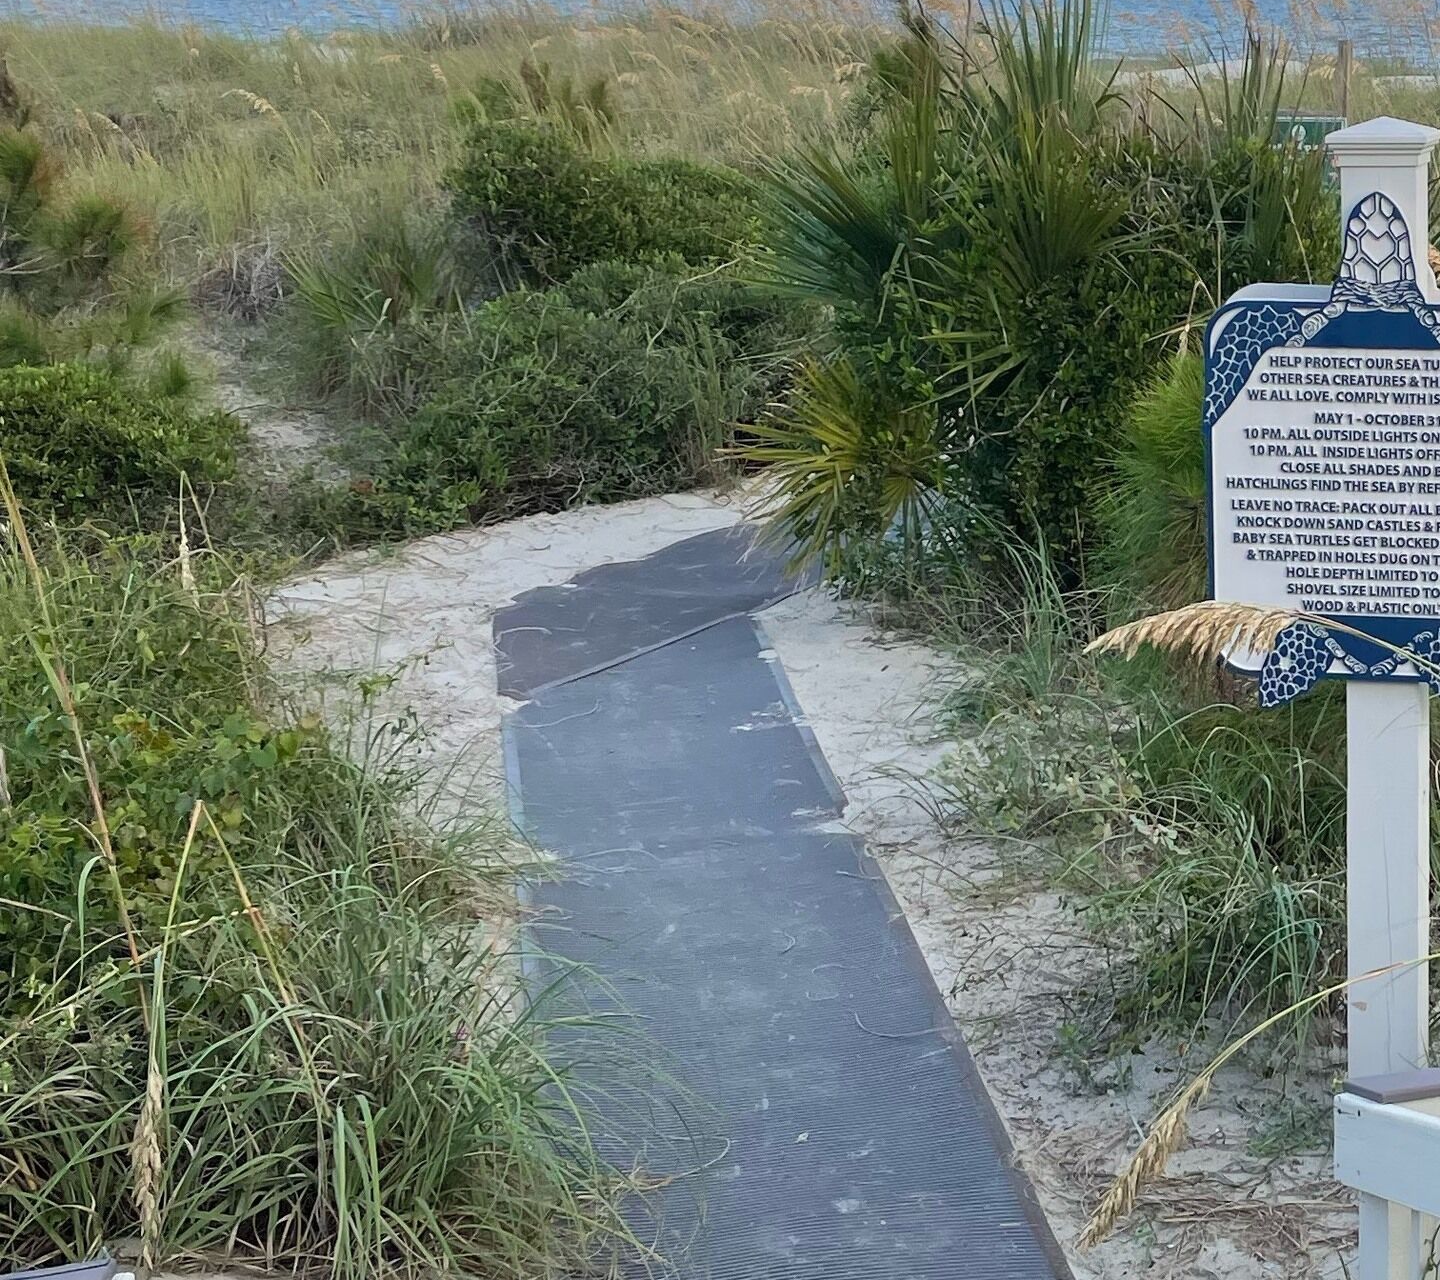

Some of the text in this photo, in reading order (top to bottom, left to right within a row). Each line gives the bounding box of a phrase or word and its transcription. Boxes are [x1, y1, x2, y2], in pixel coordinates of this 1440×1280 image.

[1270, 355, 1302, 368] HELP
[1305, 356, 1361, 369] PROTECT
[1365, 358, 1394, 370] OUR
[1397, 358, 1420, 370] SEA
[1260, 372, 1302, 384] OTHER
[1305, 373, 1330, 385] SEA
[1332, 374, 1407, 387] CREATURES
[1410, 376, 1420, 387] &
[1248, 390, 1269, 401] WE
[1271, 390, 1294, 401] ALL
[1297, 390, 1332, 402] LOVE.
[1336, 391, 1389, 403] COMPLY
[1392, 392, 1427, 404] WITH
[1314, 412, 1344, 424] MAY
[1348, 413, 1353, 424] 1
[1365, 414, 1424, 425] OCTOBER
[1244, 428, 1260, 439] 10
[1262, 428, 1286, 440] PM.
[1288, 429, 1312, 440] ALL
[1314, 429, 1369, 442] OUTSIDE
[1372, 431, 1418, 442] LIGHTS
[1421, 432, 1440, 443] ON
[1250, 444, 1265, 456] 10
[1268, 445, 1293, 457] PM.
[1294, 446, 1317, 457] ALL
[1323, 446, 1366, 458] INSIDE
[1369, 447, 1413, 459] LIGHTS
[1280, 462, 1321, 473] CLOSE
[1323, 463, 1347, 474] ALL
[1349, 463, 1400, 476] SHADES
[1403, 465, 1431, 477] AND
[1226, 478, 1308, 490] HATCHLINGS
[1311, 479, 1341, 491] FIND
[1344, 480, 1369, 492] THE
[1371, 481, 1396, 492] SEA
[1398, 482, 1415, 492] BY
[1231, 499, 1272, 512] LEAVE
[1274, 500, 1292, 512] NO
[1296, 501, 1339, 513] TRACE:
[1342, 502, 1376, 514] PACK
[1379, 503, 1406, 514] OUT
[1409, 503, 1432, 515] ALL
[1237, 516, 1283, 528] KNOCK
[1284, 517, 1326, 529] DOWN
[1328, 518, 1363, 530] SAND
[1366, 519, 1421, 531] CASTLES
[1424, 521, 1434, 532] &
[1232, 532, 1268, 544] BABY
[1269, 533, 1294, 545] SEA
[1296, 534, 1351, 546] TURTLES
[1353, 536, 1378, 547] GET
[1380, 536, 1439, 549] BLOCKED
[1247, 550, 1256, 560] &
[1259, 549, 1316, 562] TRAPPED
[1319, 551, 1332, 562] IN
[1335, 552, 1376, 564] HOLES
[1379, 553, 1408, 564] DUG
[1411, 554, 1431, 565] ON
[1286, 567, 1320, 578] HOLE
[1323, 568, 1365, 580] DEPTH
[1367, 569, 1418, 581] LIMITED
[1421, 571, 1440, 582] TO
[1287, 583, 1336, 595] SHOVEL
[1339, 585, 1366, 595] SIZE
[1368, 585, 1420, 598] LIMITED
[1302, 600, 1345, 612] WOOD
[1348, 601, 1357, 612] &
[1358, 602, 1411, 614] PLASTIC
